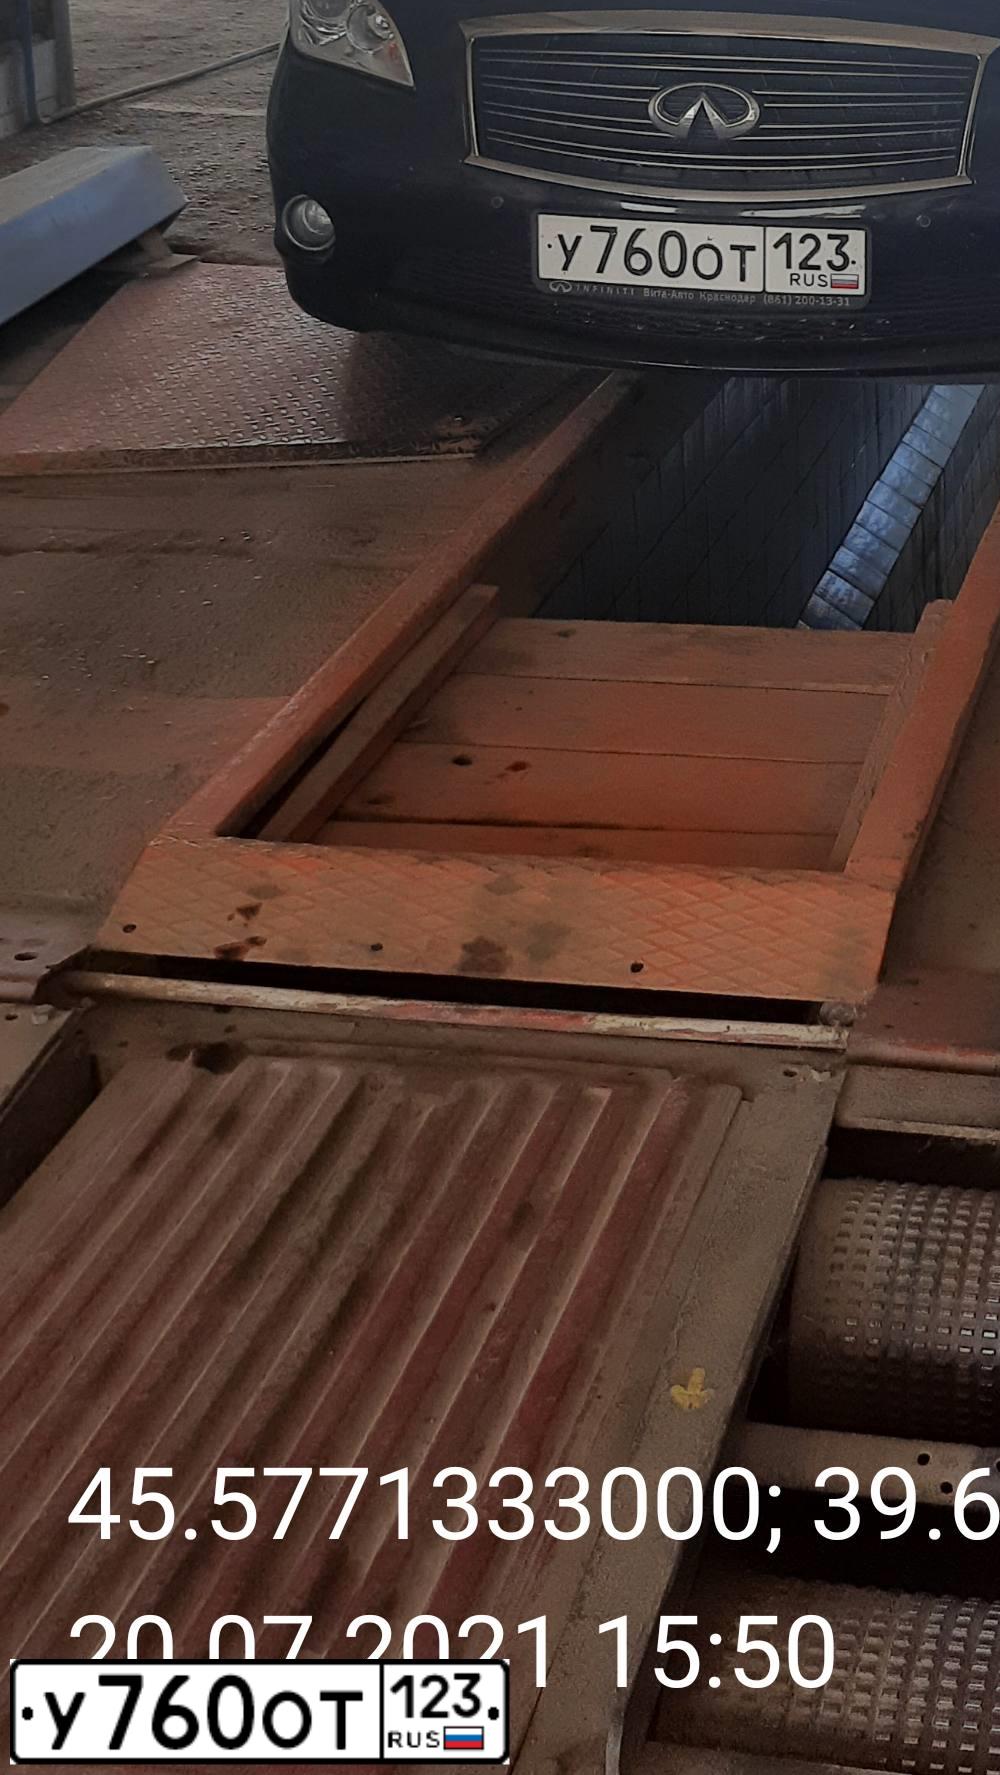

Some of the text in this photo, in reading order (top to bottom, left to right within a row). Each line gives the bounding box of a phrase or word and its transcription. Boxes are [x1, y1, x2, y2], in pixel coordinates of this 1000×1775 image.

[772, 232, 851, 272] 123
[575, 283, 635, 296] INFINITI
[788, 272, 829, 289] RUS
[643, 287, 851, 307] Вита-Авто Краснодар (861) 200-13-31
